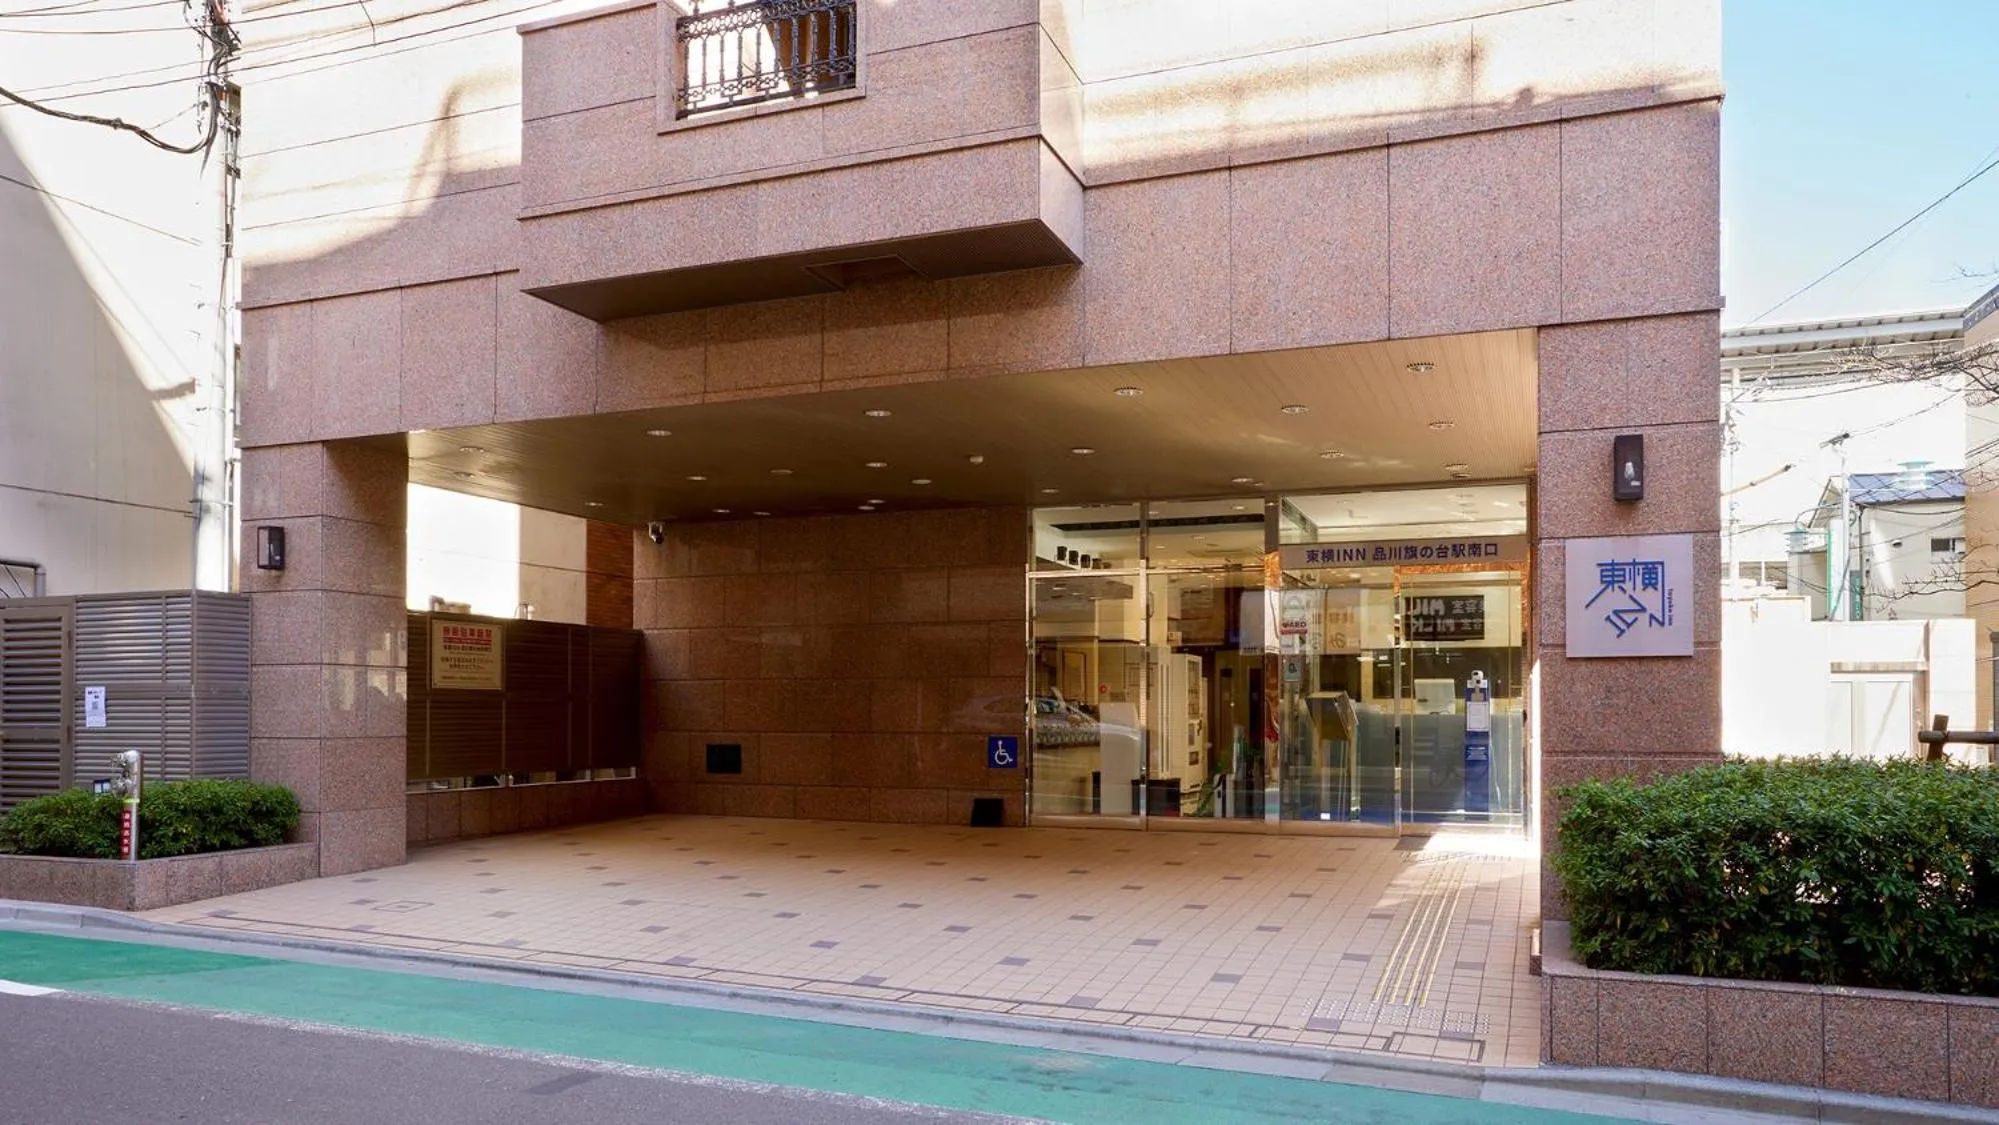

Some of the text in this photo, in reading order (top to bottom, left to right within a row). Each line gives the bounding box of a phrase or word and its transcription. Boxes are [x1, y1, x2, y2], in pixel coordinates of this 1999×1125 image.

[1305, 543, 1498, 564] 東横INN 品川旗の台駅南口
